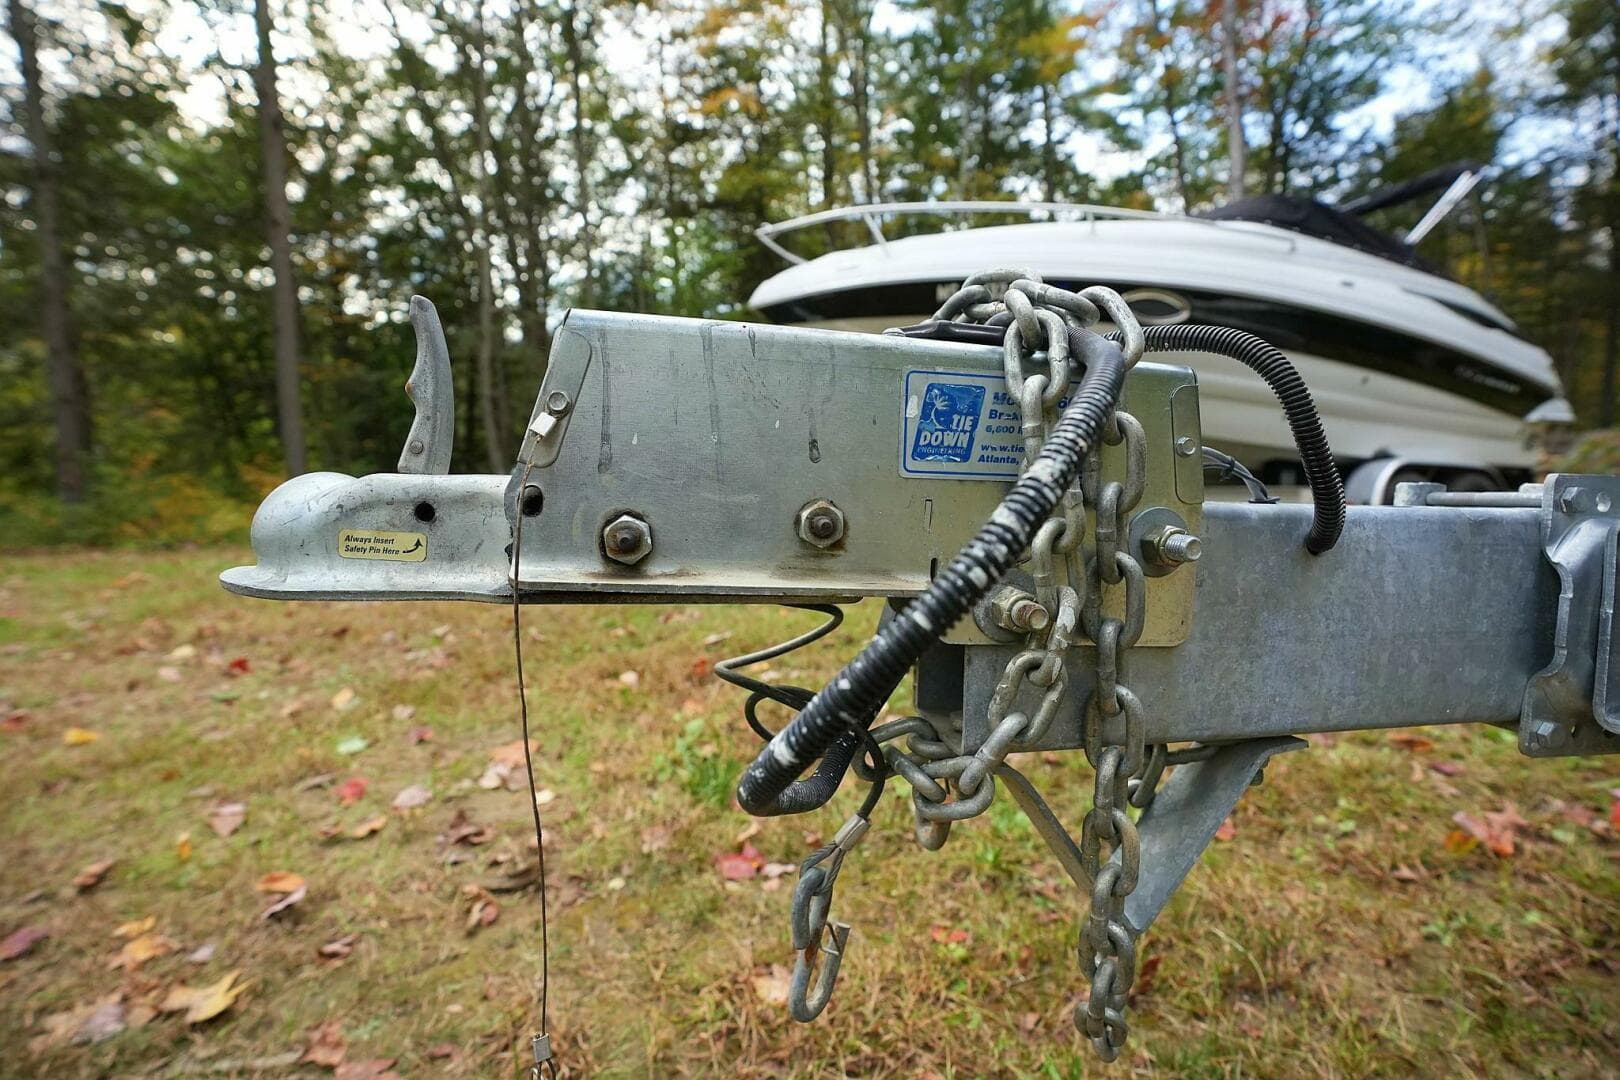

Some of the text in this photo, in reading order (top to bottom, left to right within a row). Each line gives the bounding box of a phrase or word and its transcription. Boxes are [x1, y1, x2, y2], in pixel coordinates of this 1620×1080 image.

[989, 409, 1022, 420] Brak
[952, 414, 975, 431] TIE
[985, 424, 1015, 434] 6,600
[919, 430, 970, 449] DOWN
[981, 444, 1026, 453] www.tie
[977, 454, 1020, 466] Atlanta,
[345, 535, 395, 544] Always Insert
[345, 545, 367, 554] Safety
[369, 546, 380, 554] Pin
